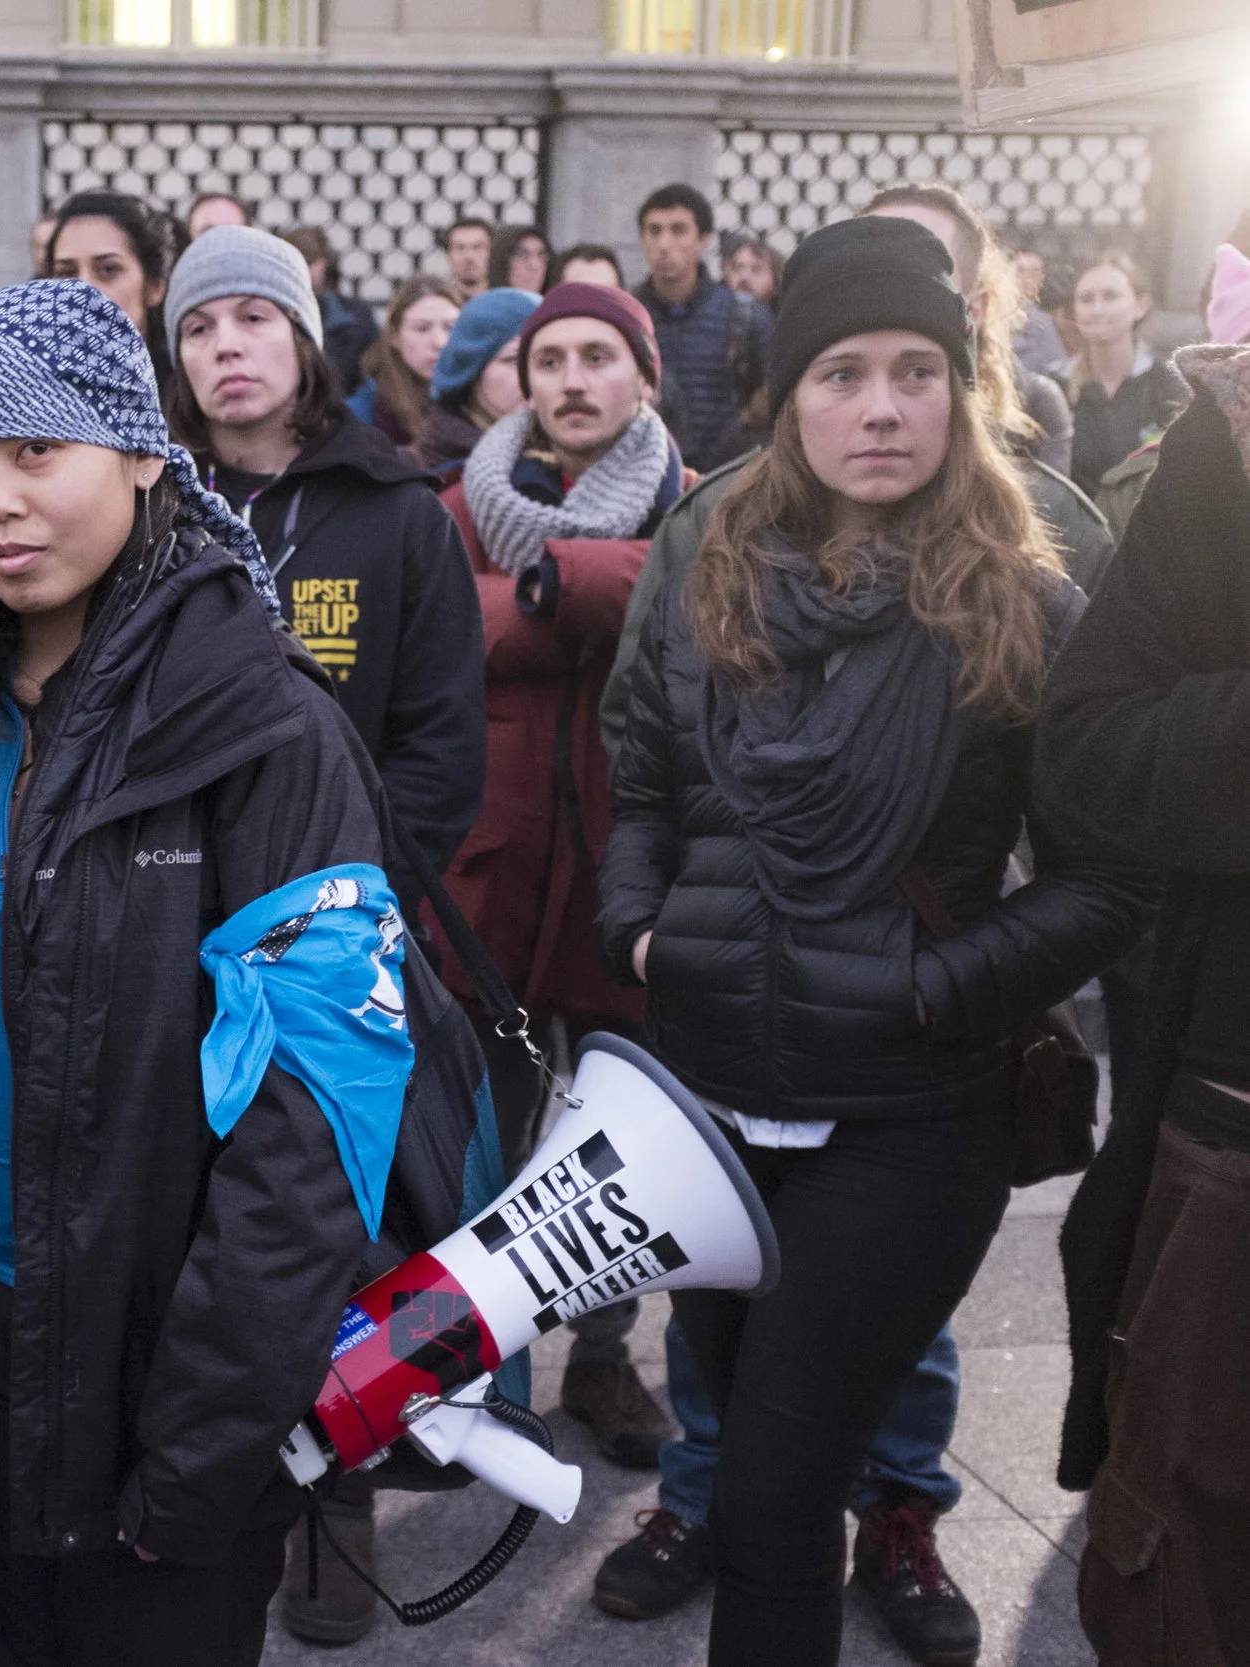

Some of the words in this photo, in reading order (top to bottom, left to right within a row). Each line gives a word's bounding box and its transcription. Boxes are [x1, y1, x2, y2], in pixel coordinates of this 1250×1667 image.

[292, 579, 360, 603] UPSET
[320, 603, 360, 635] UP
[497, 1149, 598, 1237] BLACK
[506, 1181, 650, 1306] LIVES
[553, 1247, 668, 1323] MATTER
[341, 1311, 367, 1329] THE
[331, 1322, 380, 1360] ANSWER
